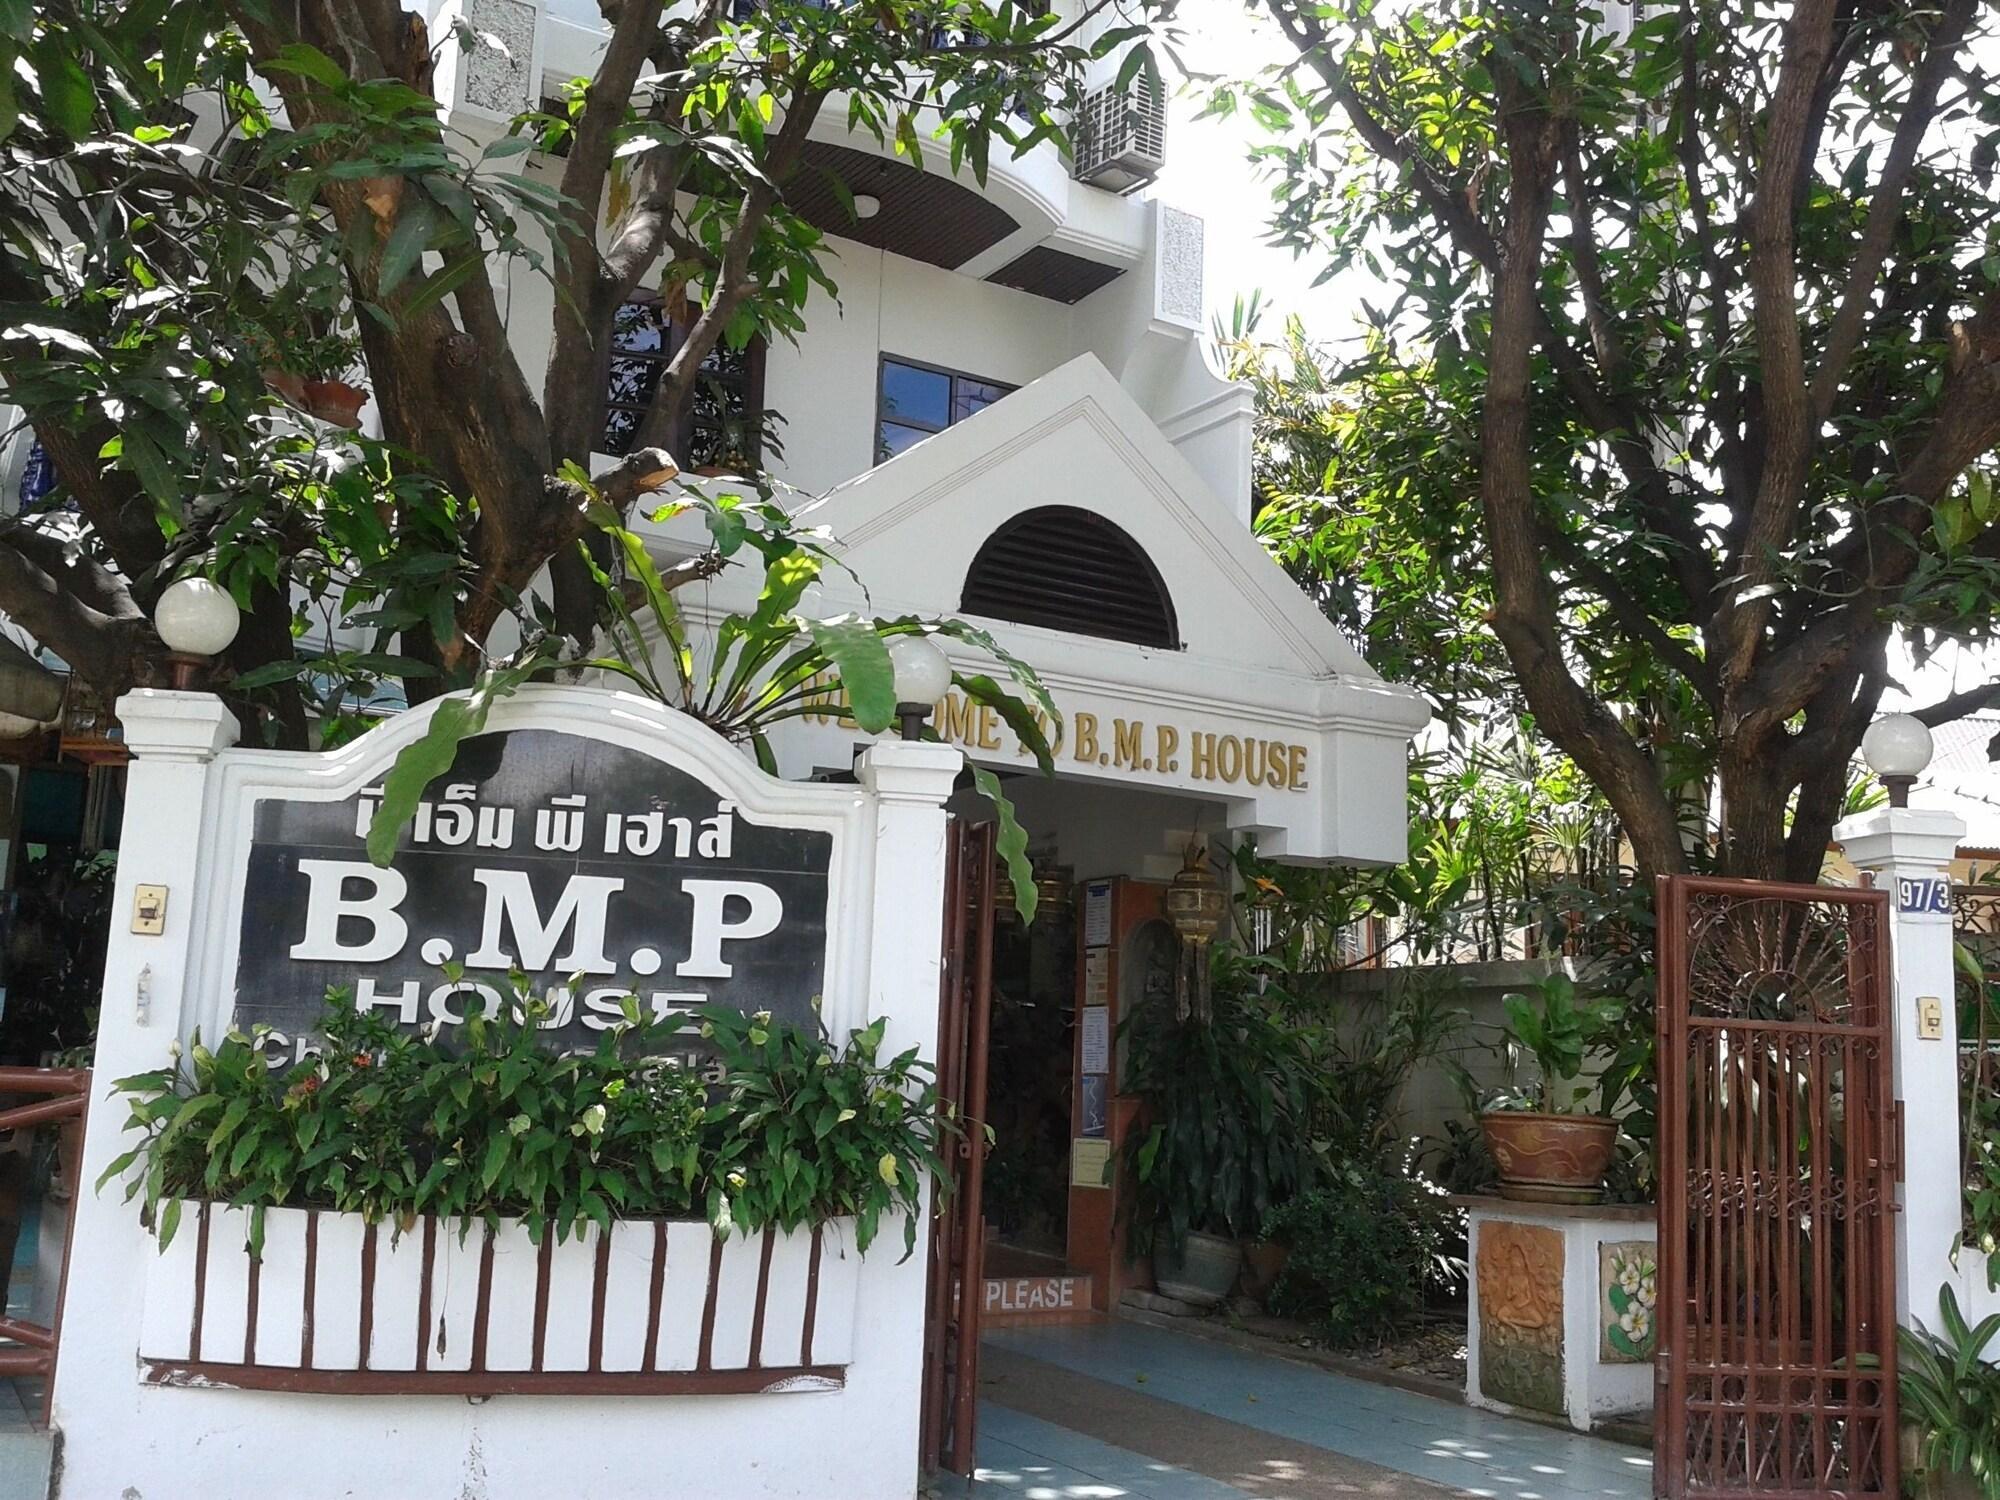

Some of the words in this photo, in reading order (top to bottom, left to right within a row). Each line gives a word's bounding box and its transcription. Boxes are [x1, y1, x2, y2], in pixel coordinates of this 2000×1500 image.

[800, 671, 1002, 750] WEOME
[1018, 703, 1065, 758] O
[1074, 712, 1179, 774] B.M.P.
[1190, 731, 1308, 792] HOUSE
[290, 859, 784, 978] B.M.P
[1901, 880, 1949, 911] 97/3
[355, 978, 708, 1034] HOUSE
[986, 1279, 1074, 1311] PLEASE
